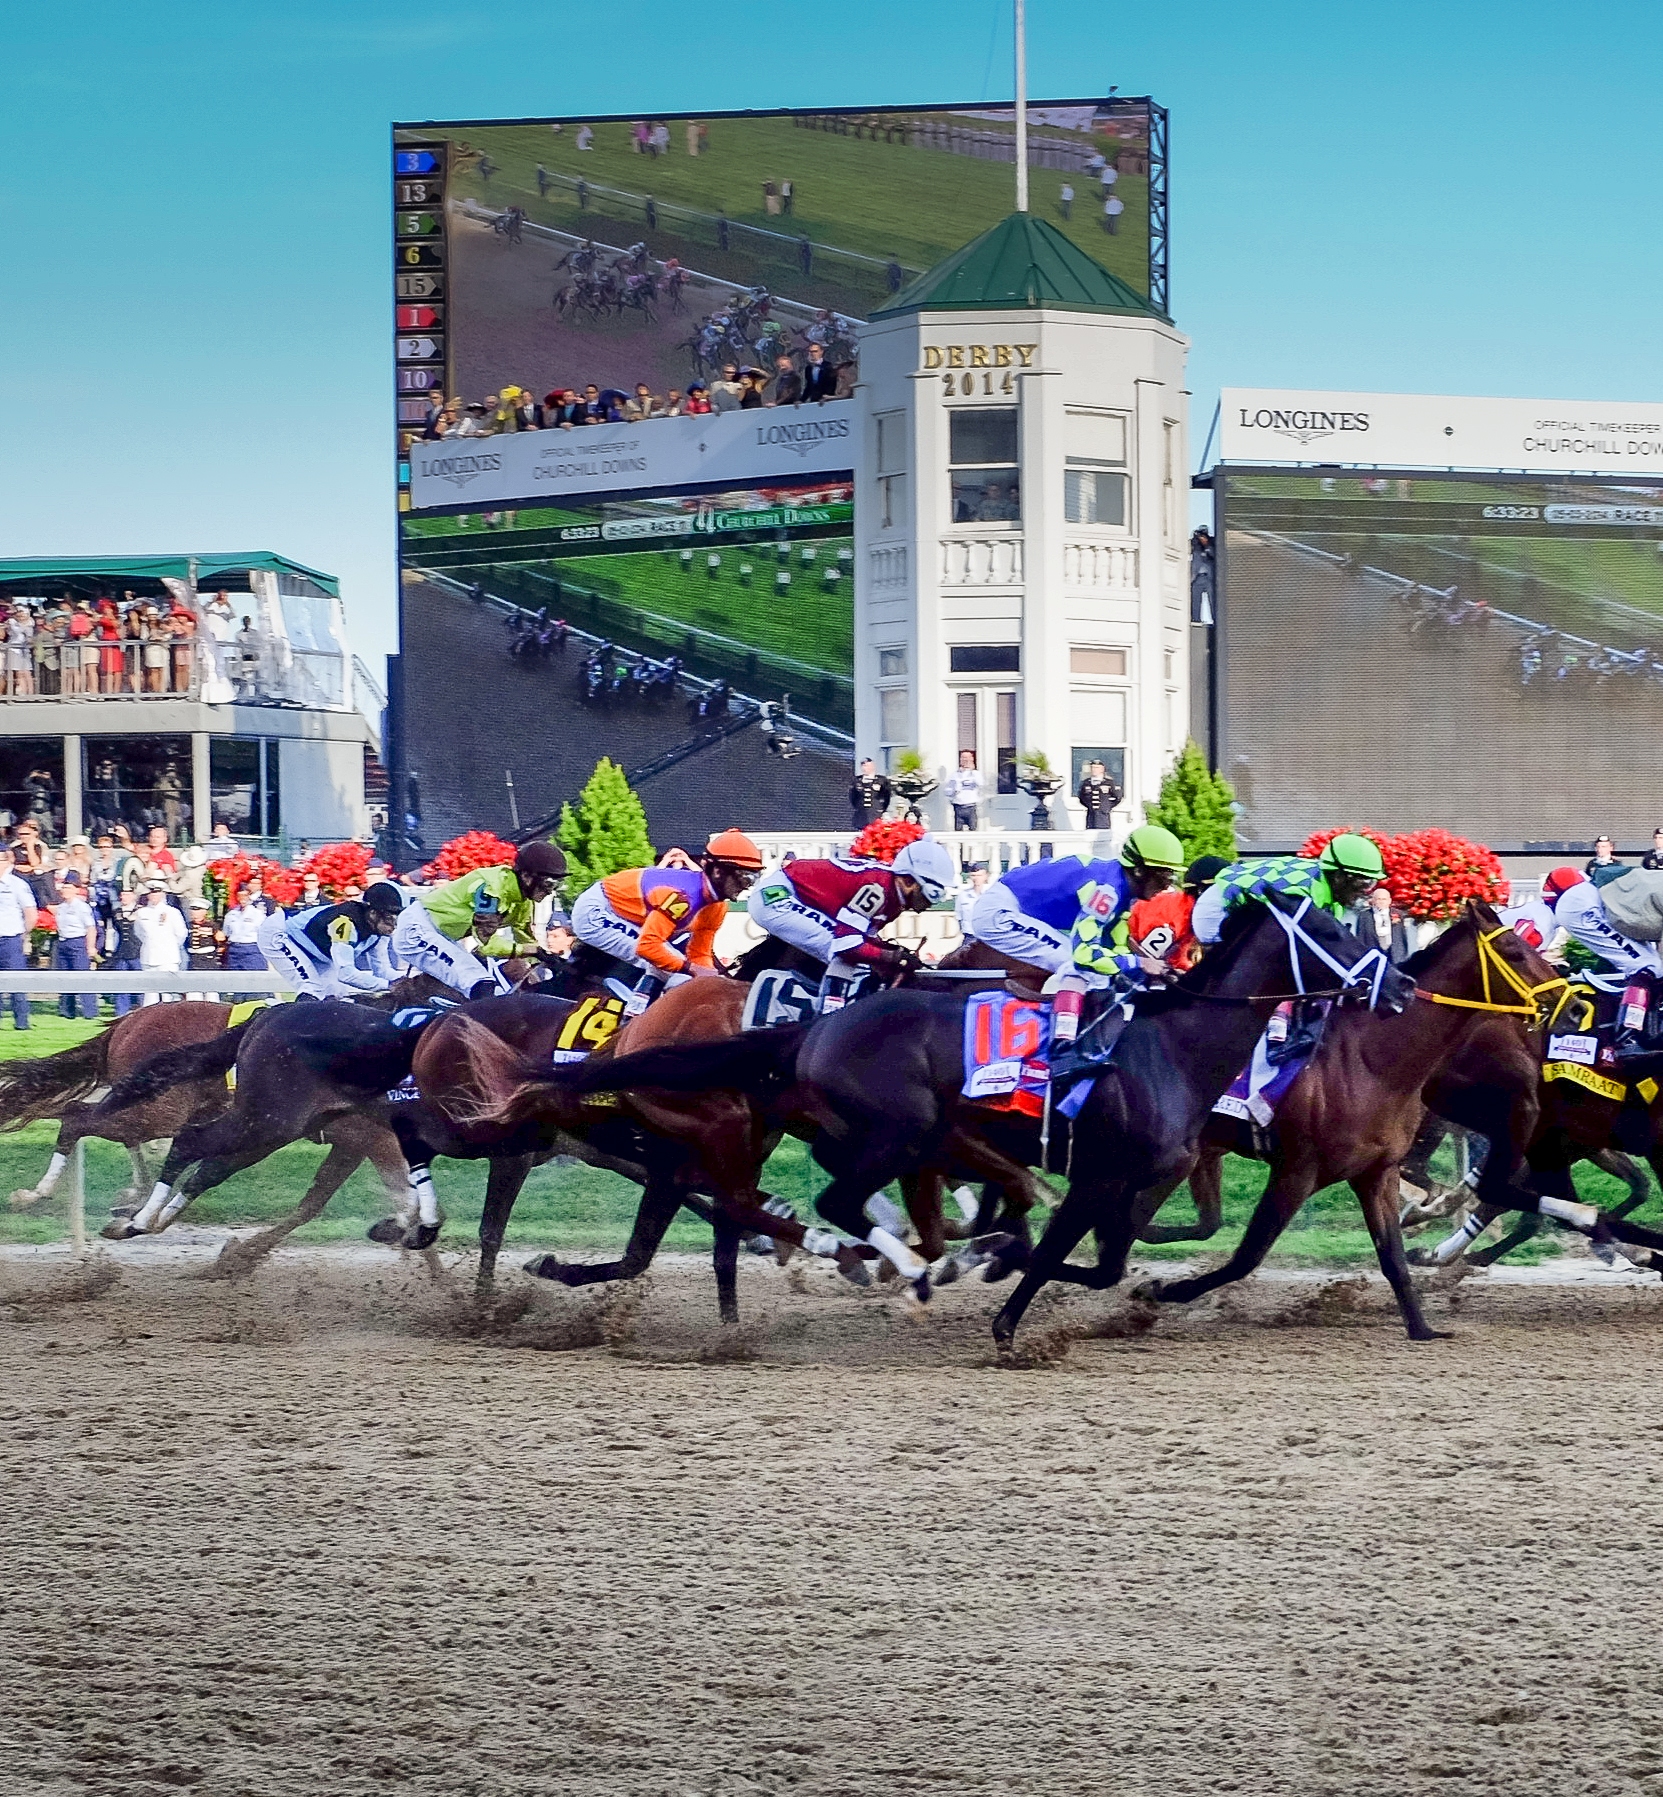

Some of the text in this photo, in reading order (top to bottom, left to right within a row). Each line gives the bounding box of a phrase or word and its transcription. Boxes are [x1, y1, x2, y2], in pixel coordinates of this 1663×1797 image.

[408, 153, 419, 170] 3
[403, 185, 426, 202] 13
[405, 216, 420, 233] 5
[405, 247, 420, 264] 6
[404, 278, 425, 294] 15
[409, 310, 420, 326] 1
[409, 340, 420, 356] 2
[923, 344, 1038, 369] DERBY
[404, 371, 428, 388] 10
[942, 371, 1016, 397] 2014
[756, 418, 850, 446] LONGINES
[1239, 408, 1370, 432] LONGINES
[1522, 437, 1622, 454] CHURCHILL
[421, 453, 502, 477] LONGINES
[659, 892, 690, 920] 14
[856, 888, 880, 914] 15
[1088, 890, 1115, 916] 16
[335, 922, 347, 940] 4
[1011, 920, 1062, 950] RAM
[1149, 932, 1167, 952] 2
[1596, 923, 1641, 960] RAM
[280, 945, 310, 982] RAM
[417, 939, 455, 968] RAM
[752, 976, 819, 1027] 15
[557, 997, 624, 1051] 14
[975, 999, 1041, 1065] 16
[1550, 1063, 1619, 1095] SAMRAAT
